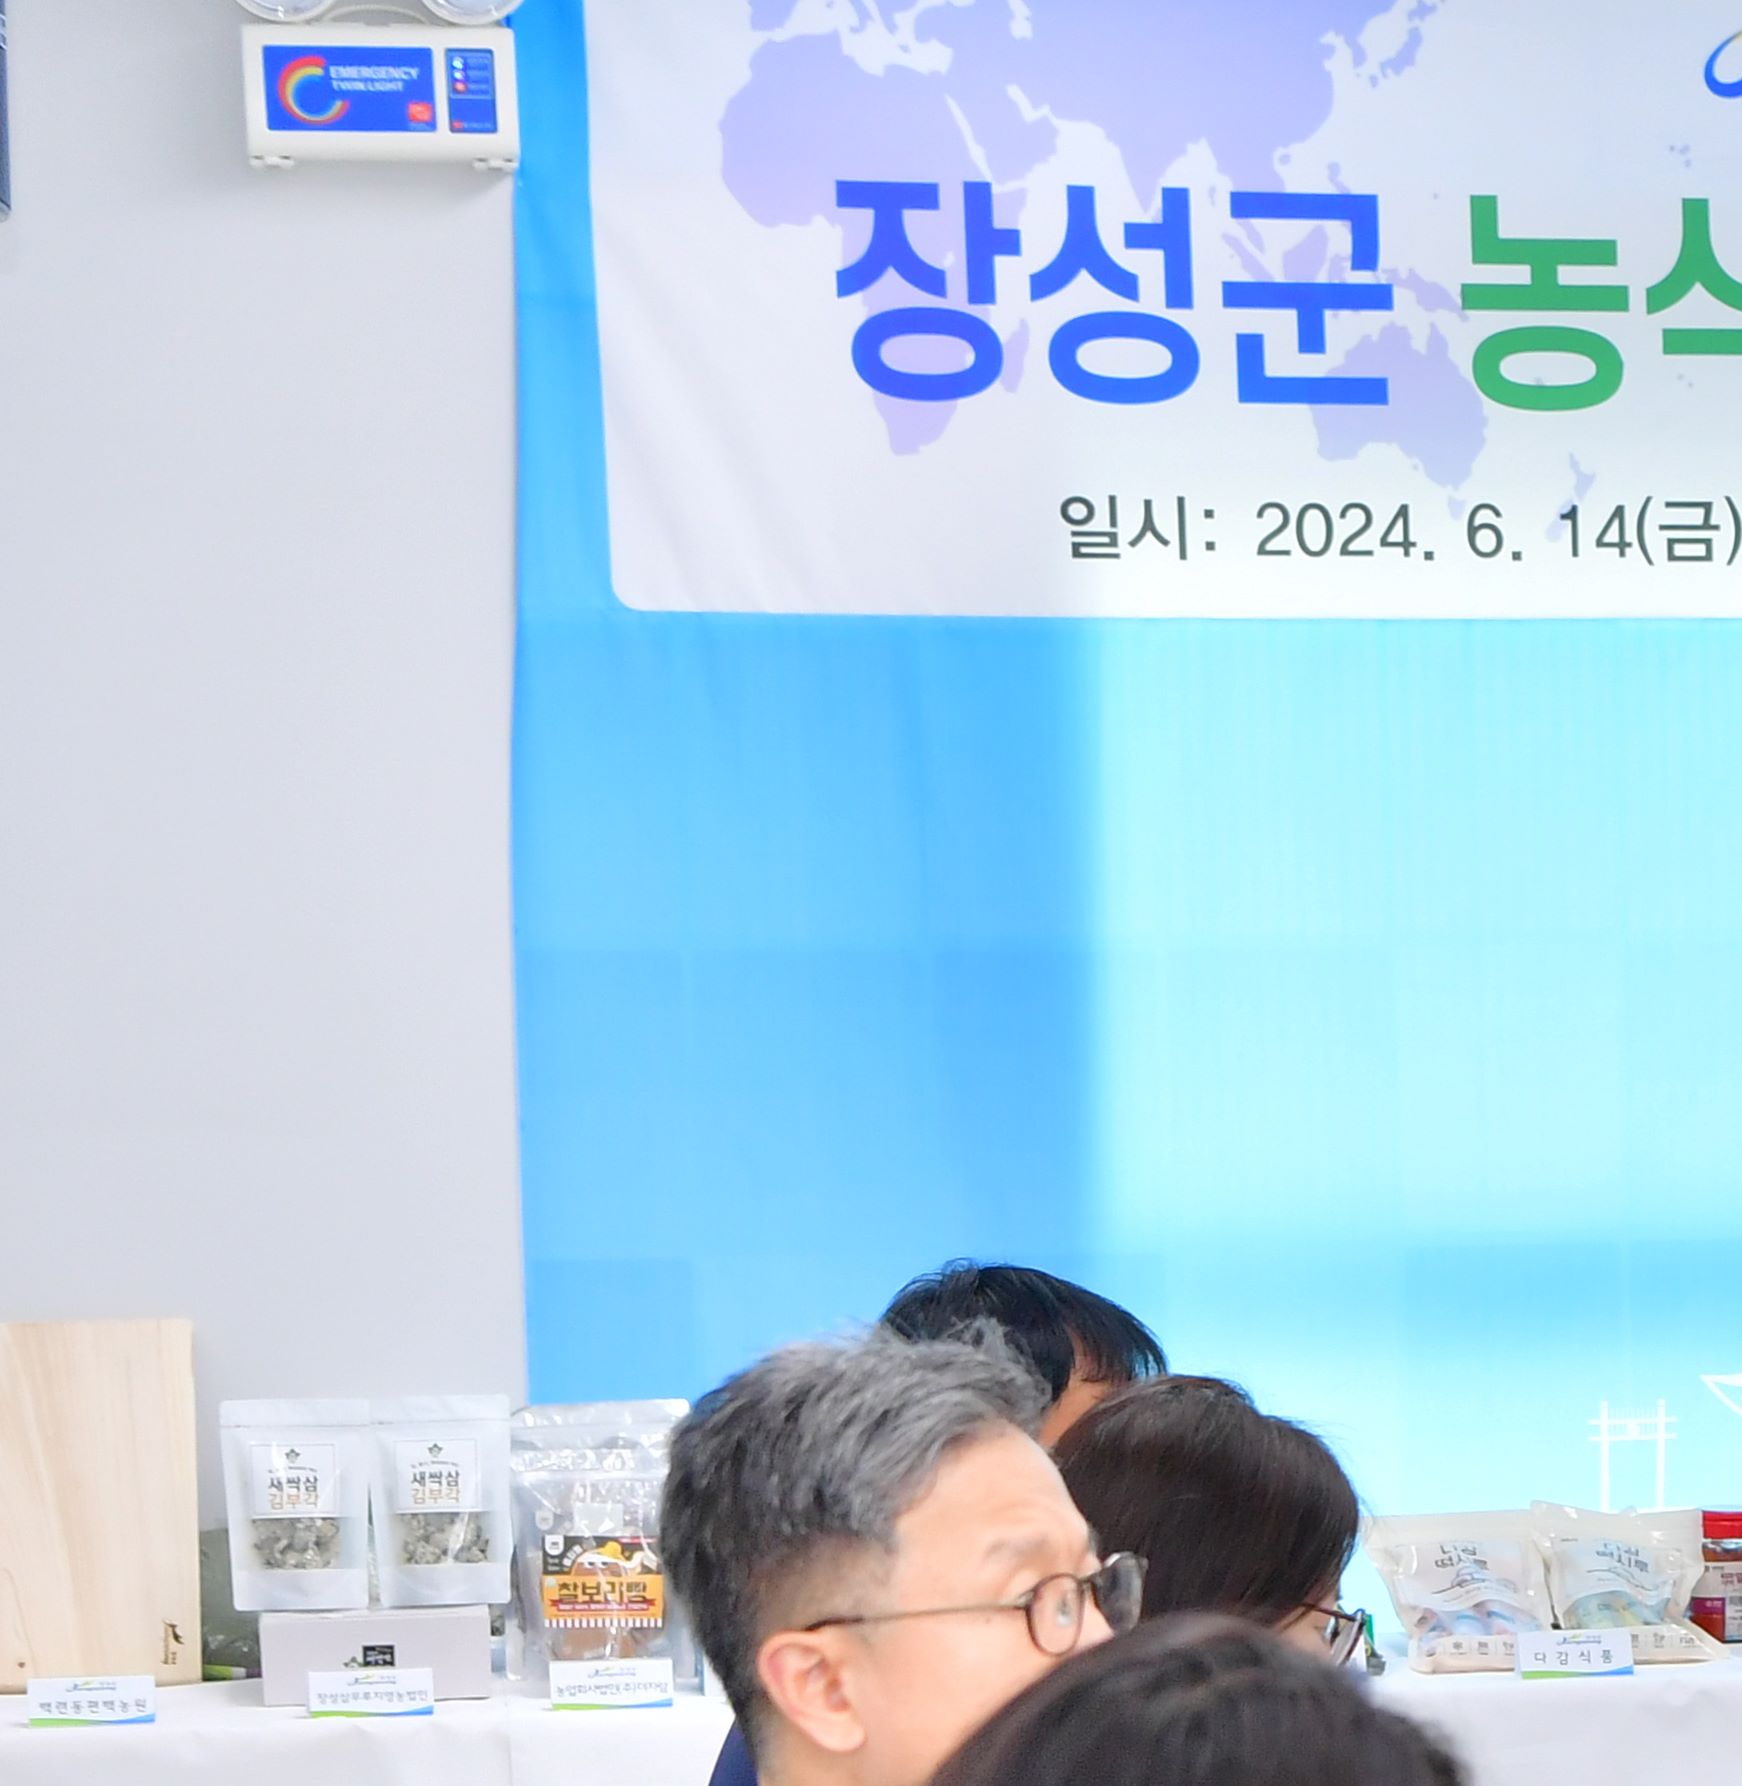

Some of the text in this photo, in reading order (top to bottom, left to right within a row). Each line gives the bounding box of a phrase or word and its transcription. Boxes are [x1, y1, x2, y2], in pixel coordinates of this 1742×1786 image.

[329, 65, 419, 80] EMERGENCY
[835, 179, 1394, 406] 장성군
[1059, 494, 1216, 561] 일시:
[1256, 501, 1435, 562] 2024.
[1466, 502, 1523, 562] 6.
[1559, 495, 1742, 566] 14(금)
[268, 1476, 319, 1493] 새싹삼
[411, 1470, 461, 1488] 새싹삼
[269, 1492, 319, 1511] 김부각
[411, 1487, 461, 1505] 김부각
